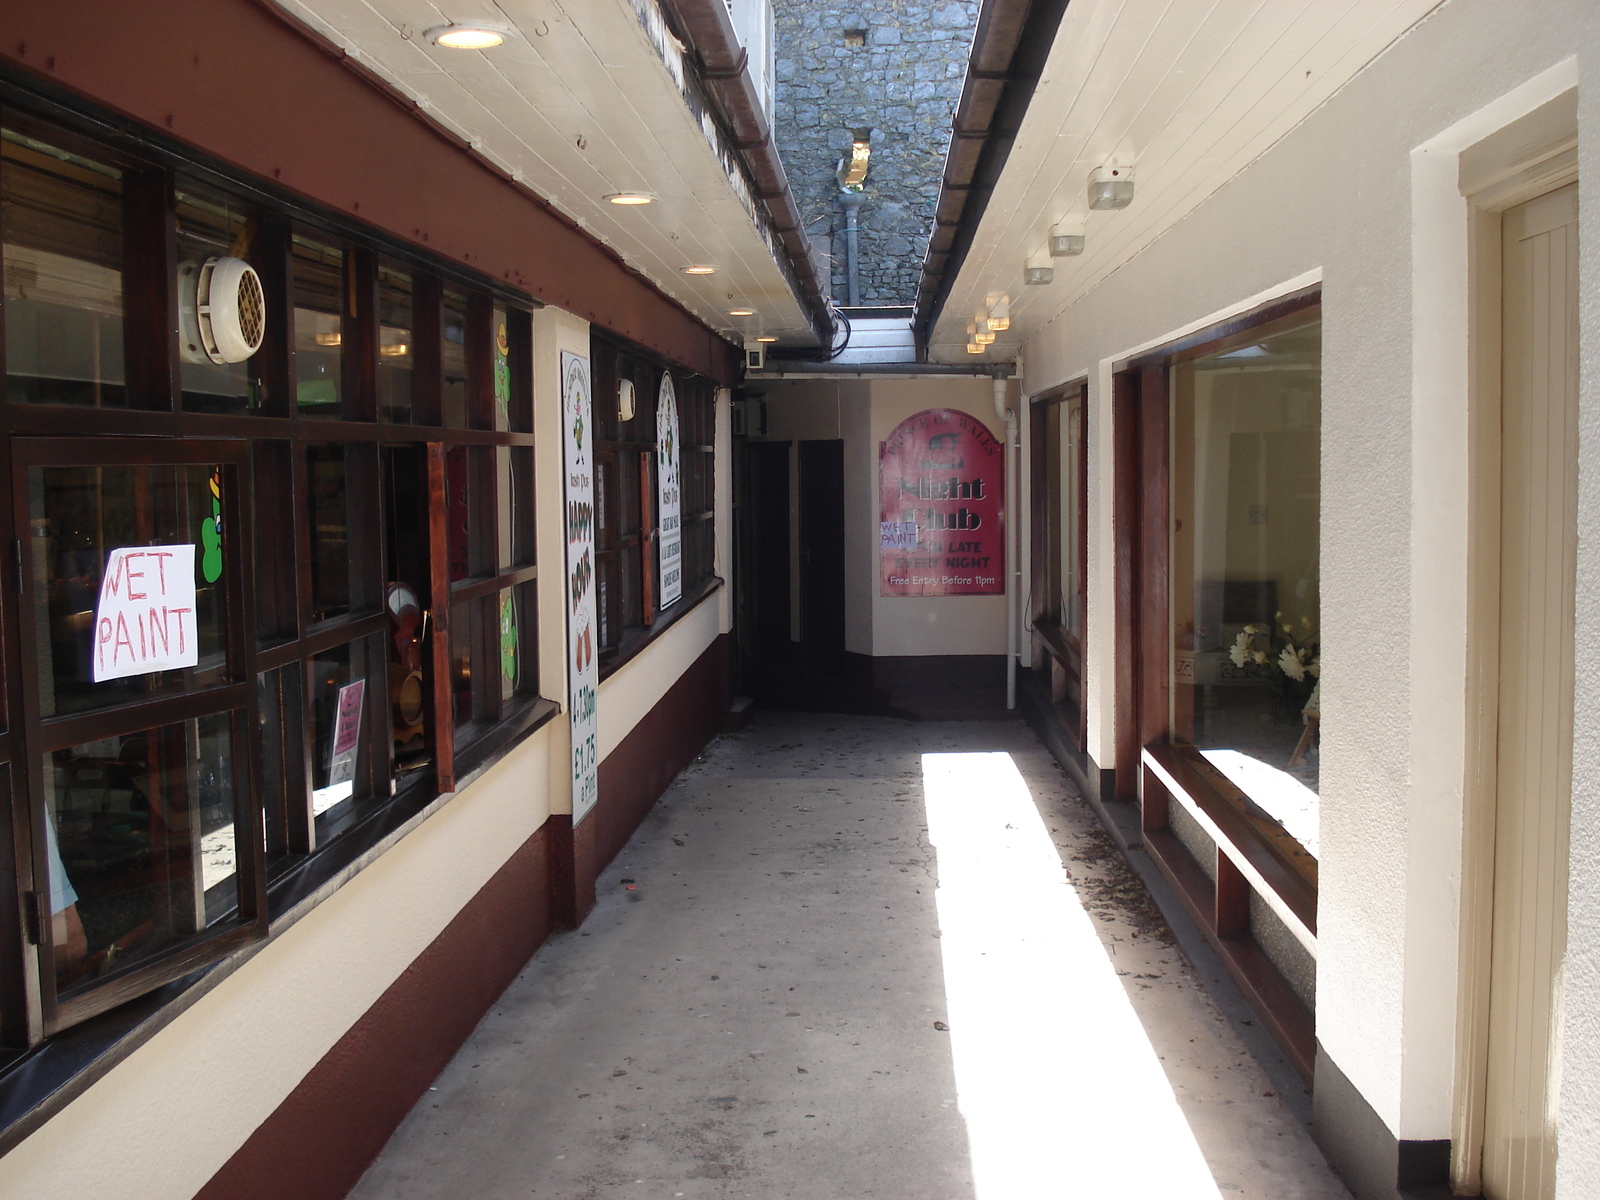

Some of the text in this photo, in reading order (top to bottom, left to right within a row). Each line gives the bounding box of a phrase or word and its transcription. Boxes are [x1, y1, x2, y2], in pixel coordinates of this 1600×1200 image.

[958, 417, 998, 456] WALES
[899, 477, 987, 501] Night
[568, 499, 593, 545] HAPPY
[881, 522, 912, 533] WET
[902, 508, 982, 531] Club
[881, 533, 916, 546] PAINT
[948, 542, 983, 553] LATE
[895, 557, 991, 569] EVERY NIGHT
[105, 552, 173, 602] WET
[571, 546, 592, 615] HOUR
[890, 575, 995, 587] Free Entry Before 11pm
[99, 605, 192, 672] PAINT
[575, 733, 596, 781] £1.75
